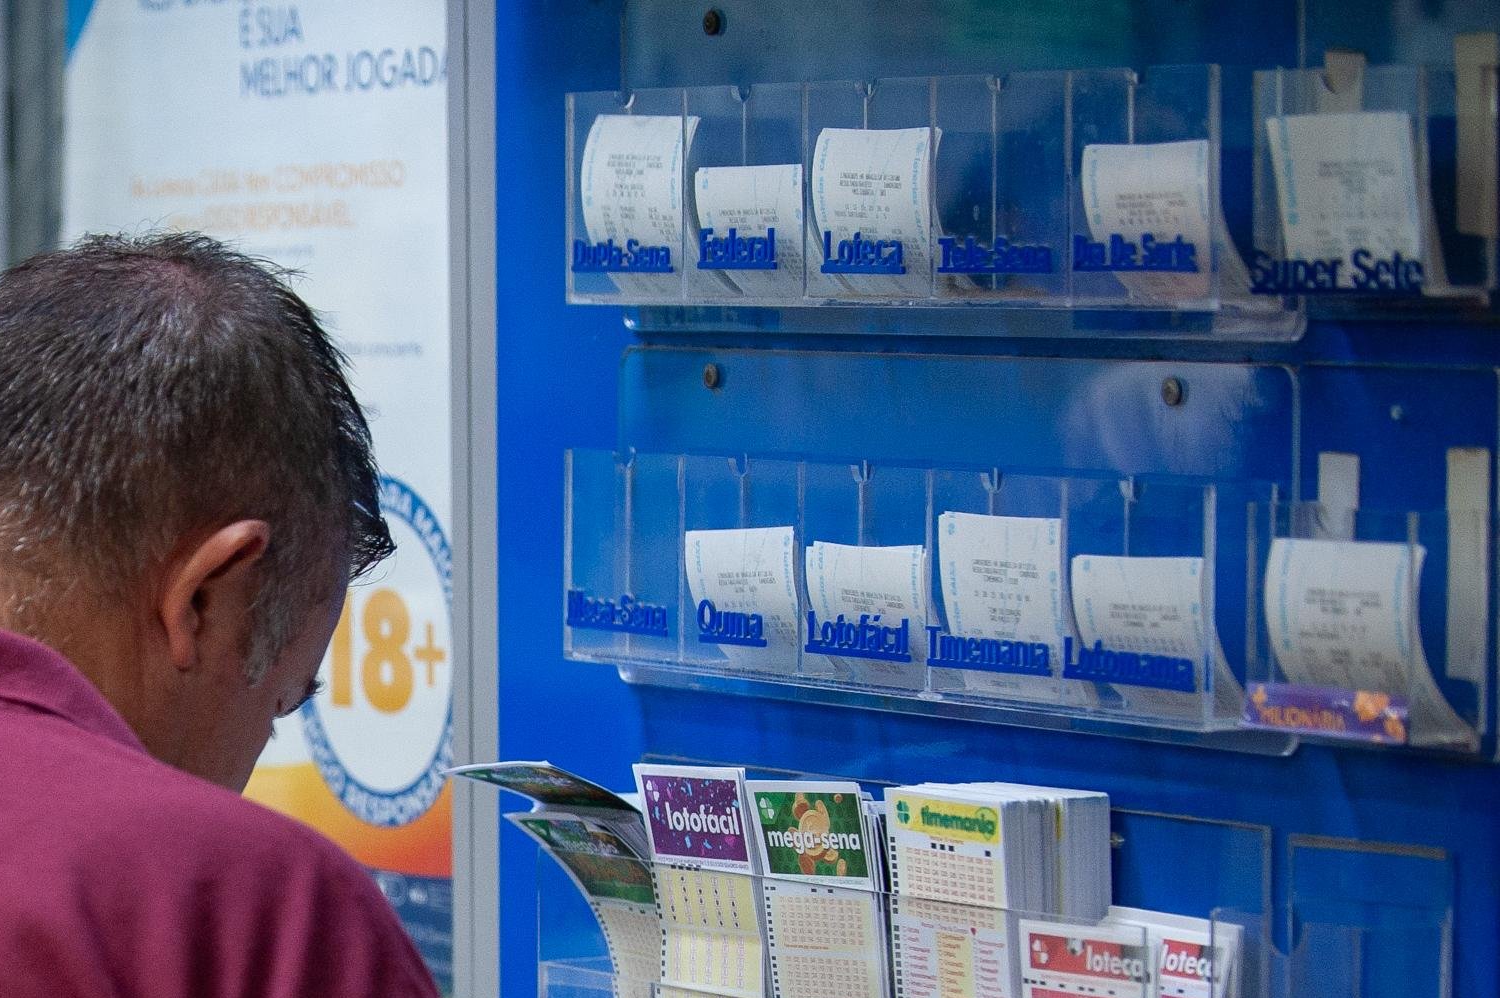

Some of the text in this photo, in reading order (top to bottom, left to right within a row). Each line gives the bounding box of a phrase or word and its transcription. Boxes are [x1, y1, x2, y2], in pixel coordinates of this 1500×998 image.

[256, 4, 303, 46] SUA
[240, 53, 338, 97] MELHOR
[699, 228, 776, 265] Federal
[822, 231, 904, 268] Loteca
[1250, 247, 1423, 291] Super Sete
[697, 600, 763, 643] Quina
[806, 610, 910, 658] Lotofácil
[330, 588, 446, 715] 18+
[665, 802, 740, 835] lotofácil
[921, 805, 995, 836] timemania
[767, 830, 861, 854] mega-sena
[1086, 944, 1143, 977] loteca
